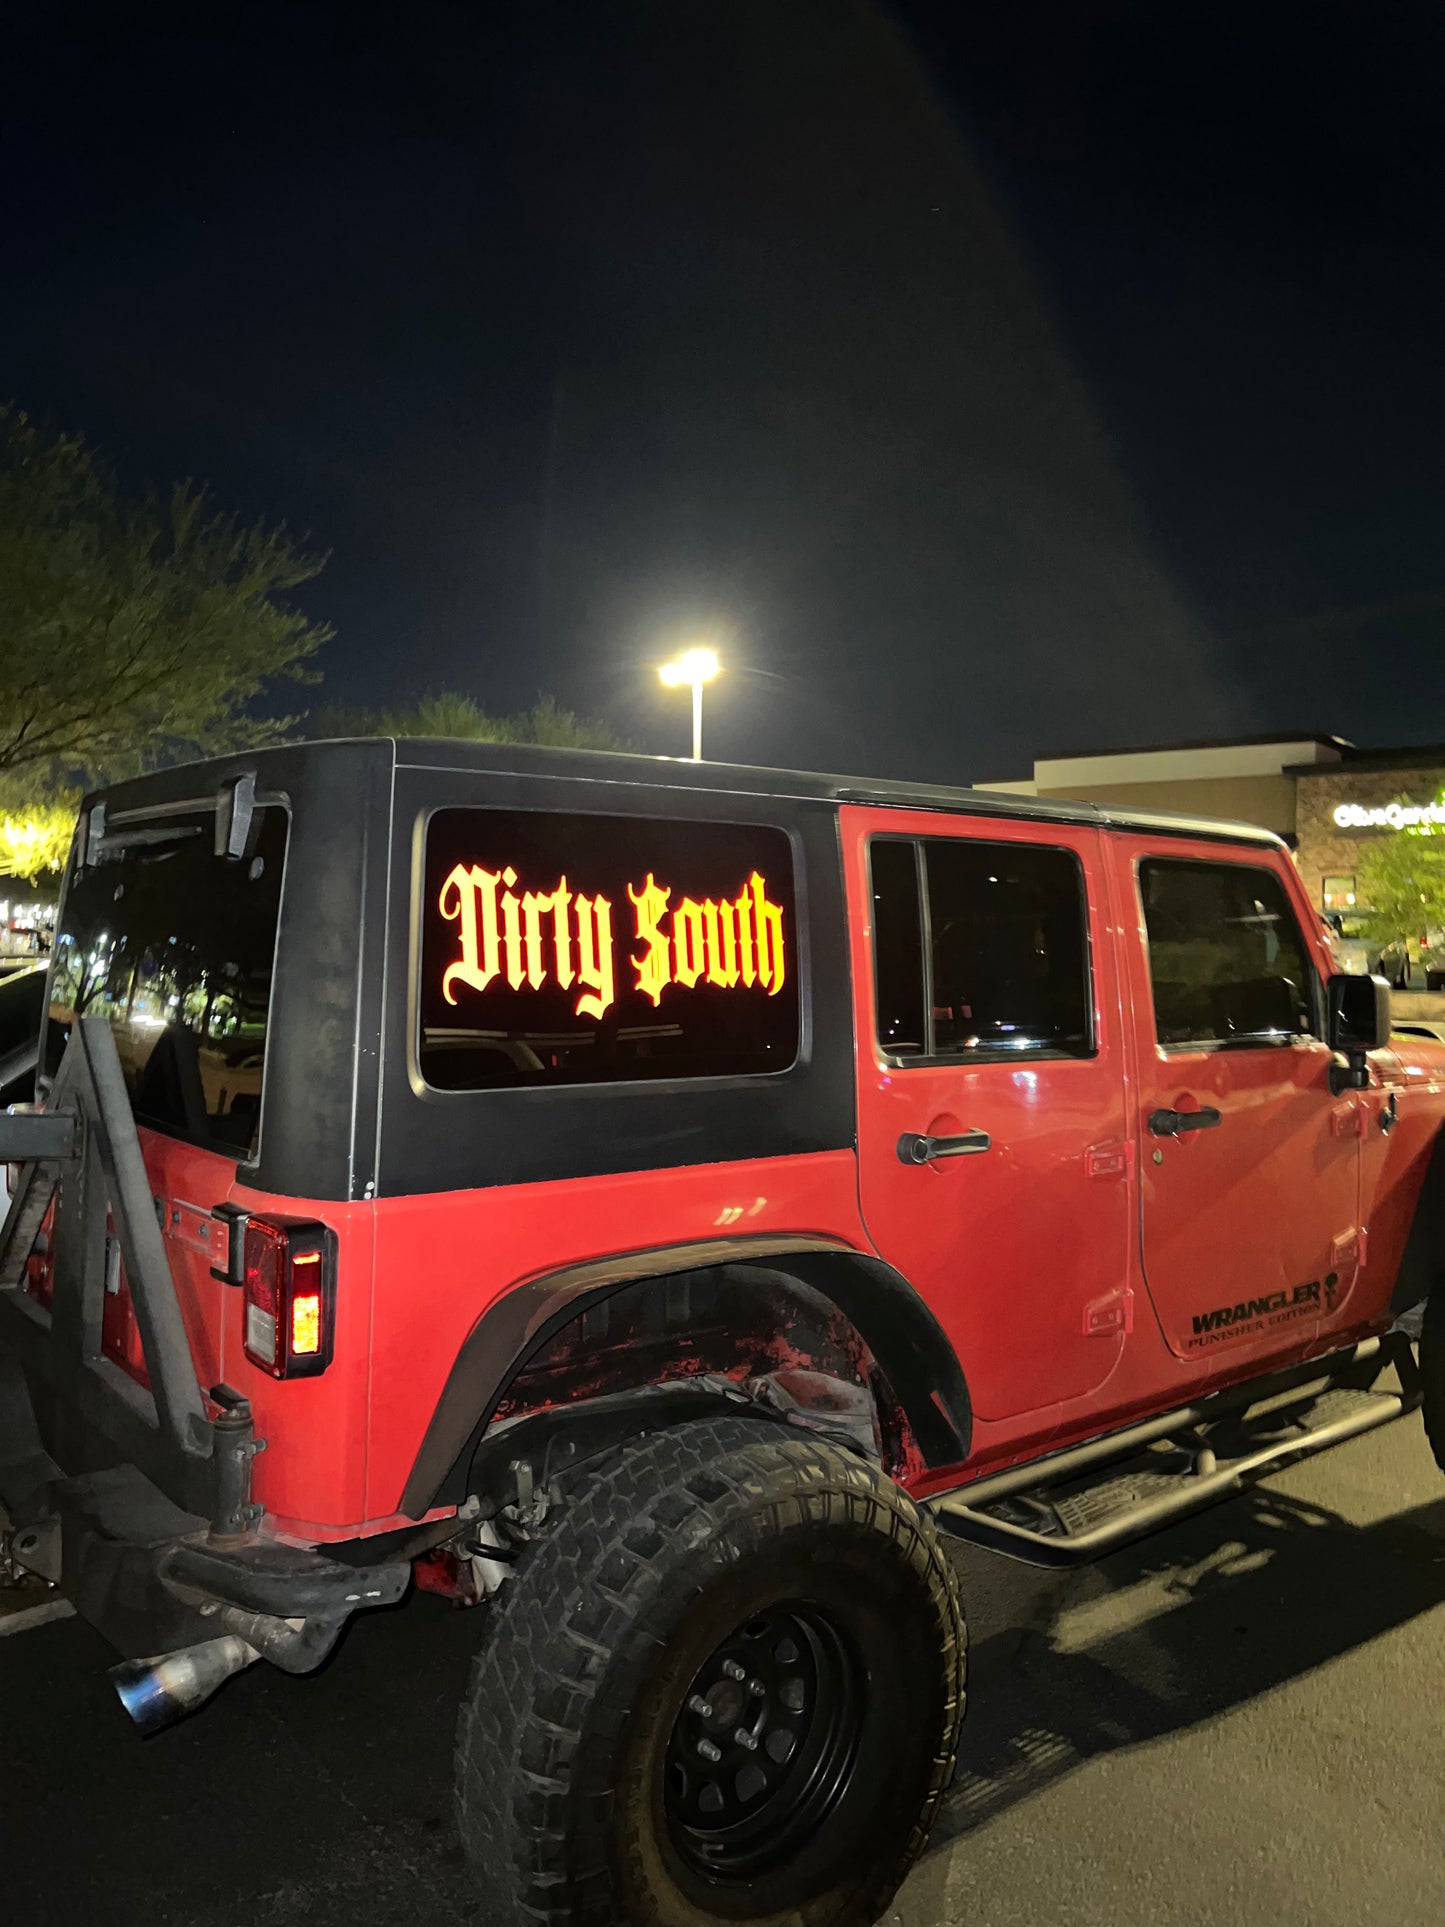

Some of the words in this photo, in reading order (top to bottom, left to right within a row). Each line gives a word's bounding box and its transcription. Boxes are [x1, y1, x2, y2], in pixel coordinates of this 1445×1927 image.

[439, 863, 614, 1020] Dirty
[1188, 1320, 1264, 1349] PUNISHER
[1268, 1302, 1320, 1326] EDITION
[1192, 1281, 1321, 1335] WRANGLER
